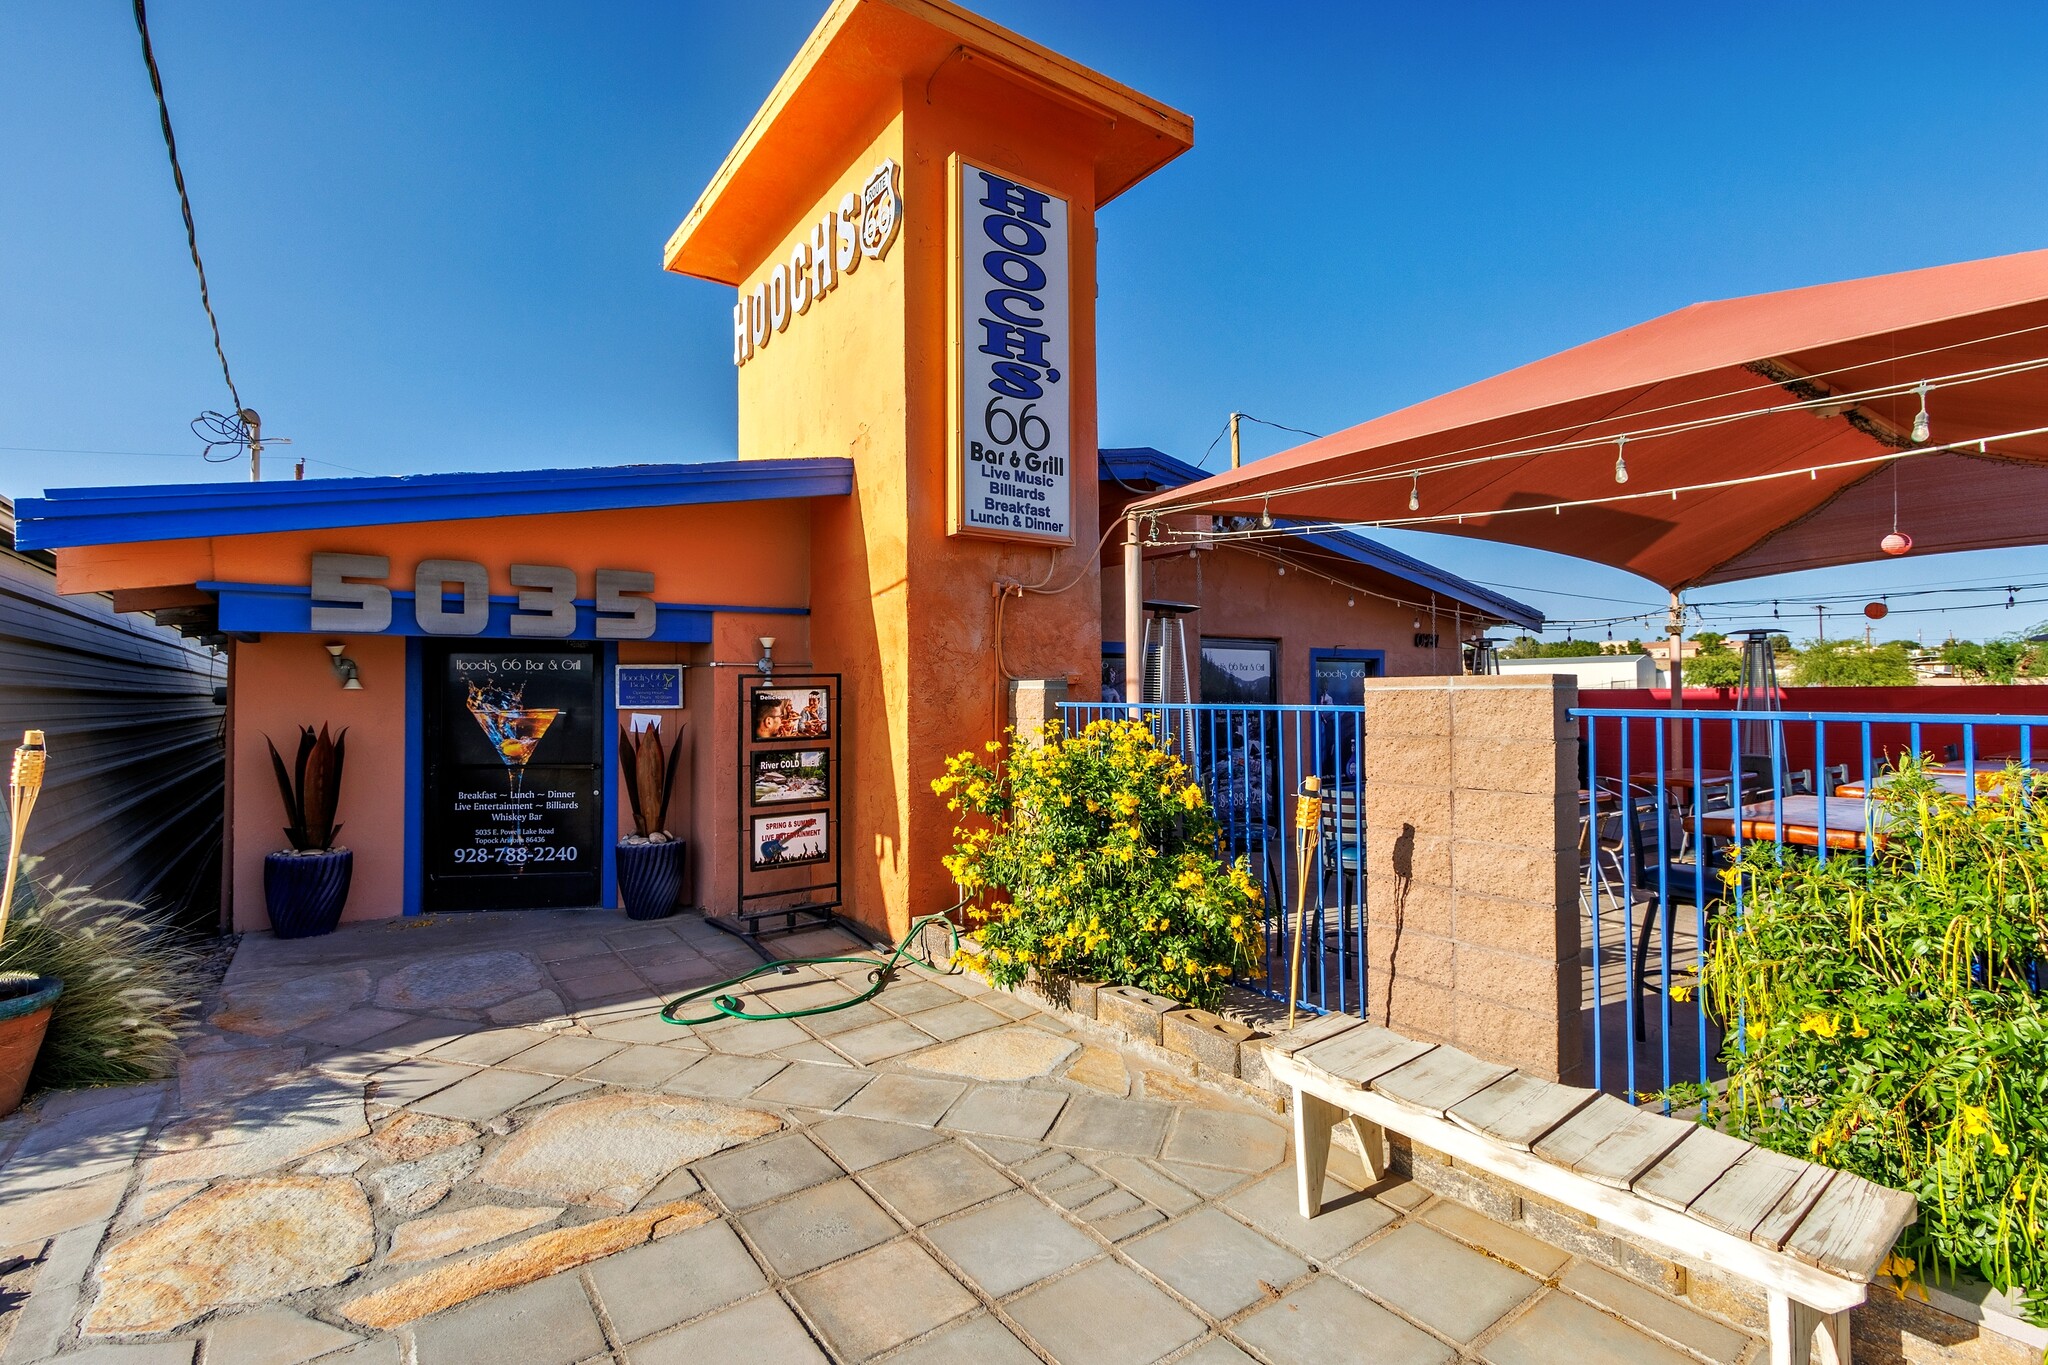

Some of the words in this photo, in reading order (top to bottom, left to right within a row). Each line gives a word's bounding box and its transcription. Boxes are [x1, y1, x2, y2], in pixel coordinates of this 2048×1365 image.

[868, 176, 886, 202] ROUTE
[865, 190, 891, 246] 66
[734, 192, 861, 367] HOOCHS
[978, 171, 1060, 400] HOOCH'S
[985, 396, 1050, 451] 66
[970, 440, 1005, 466] Bar
[1009, 450, 1021, 468] &
[1024, 452, 1064, 476] Grill
[981, 464, 1010, 480] Live
[1014, 469, 1054, 488] Music
[989, 481, 1046, 501] Billiards
[984, 497, 1051, 518] Breakfast
[970, 509, 1009, 526] Lunch
[1012, 514, 1022, 527] &
[1025, 516, 1064, 533] Dinner
[311, 552, 656, 639] 5035
[457, 659, 497, 673] Hooch's
[501, 658, 521, 671] 66
[526, 660, 544, 670] Bar
[548, 660, 558, 670] &
[561, 660, 581, 670] Grill
[1228, 662, 1238, 670] 66
[1240, 663, 1248, 671] Bar
[1316, 669, 1348, 680] Hooch's
[1350, 668, 1366, 678] 66
[621, 673, 650, 683] Hooch's
[760, 762, 779, 770] River
[780, 760, 800, 768] COLD
[458, 791, 497, 800] Breakfast
[510, 790, 534, 799] Lunch
[548, 790, 576, 798] Dinner
[454, 802, 472, 811] Live
[474, 802, 533, 811] Entertainment
[546, 801, 578, 810] Billiards
[492, 812, 527, 822] Whiskey
[529, 812, 542, 820] Bar
[766, 822, 787, 830] SPRING
[454, 846, 578, 863] 928-788-2240
